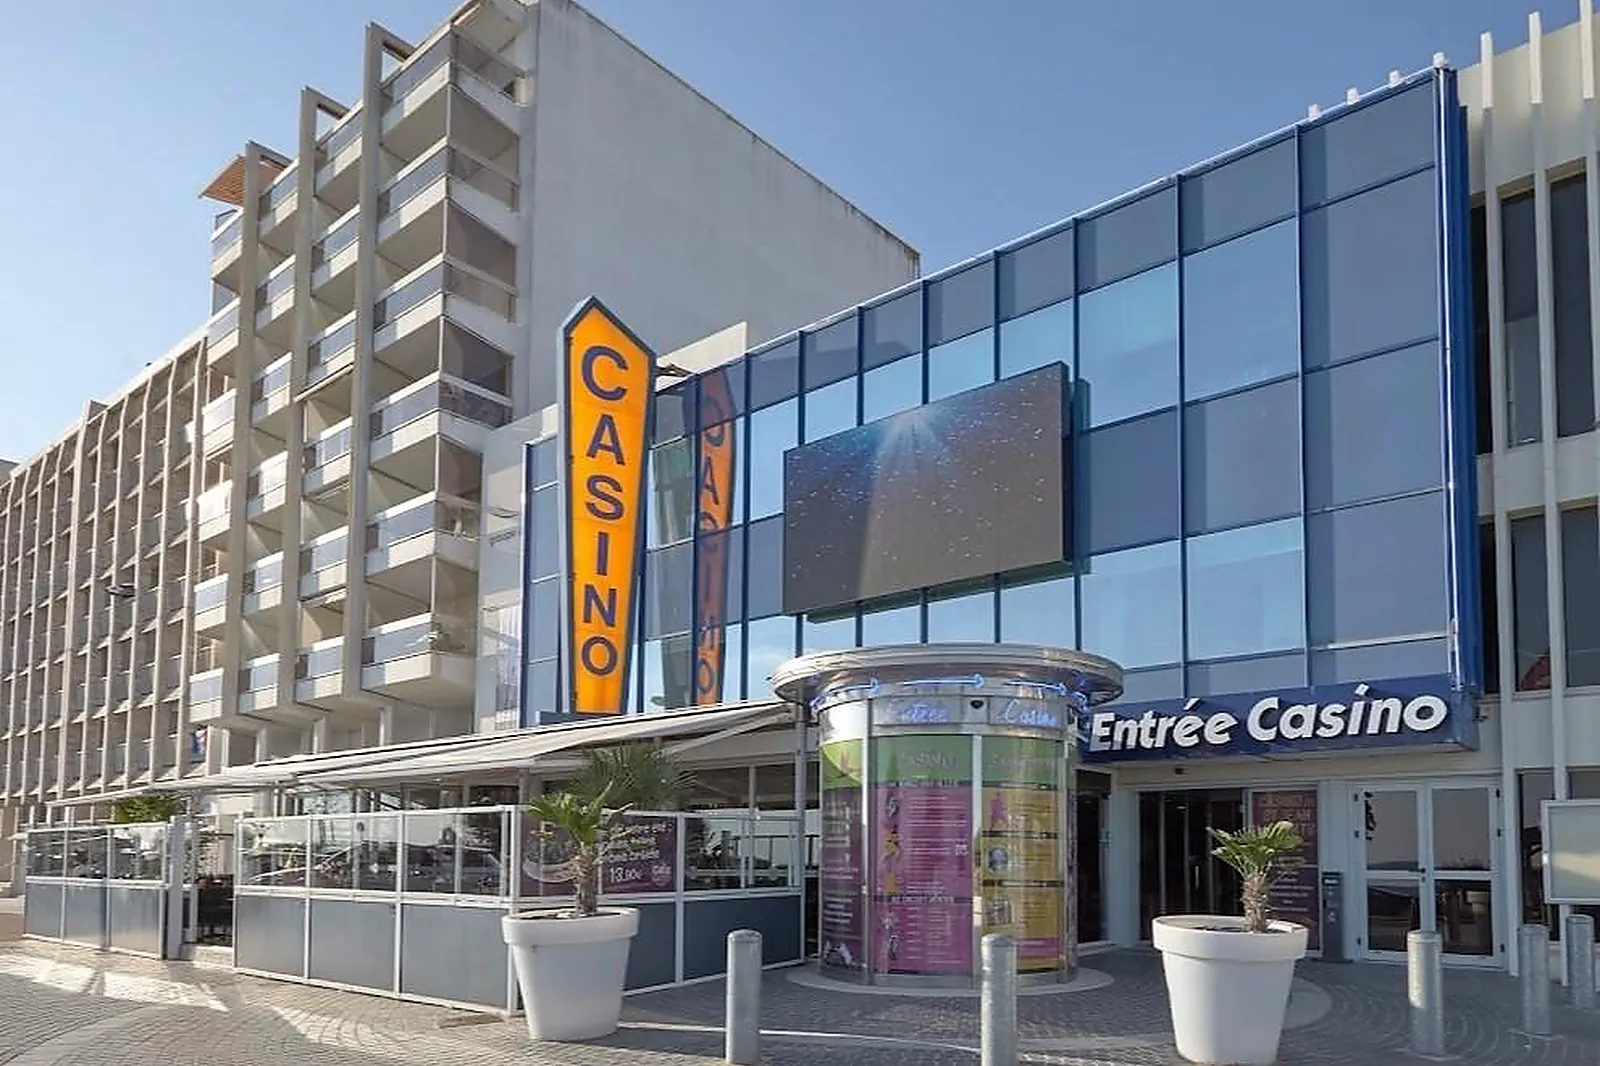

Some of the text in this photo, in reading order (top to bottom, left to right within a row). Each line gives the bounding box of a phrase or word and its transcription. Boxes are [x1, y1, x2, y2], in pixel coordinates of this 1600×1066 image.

[581, 345, 628, 676] CASINO
[1089, 683, 1448, 751] Entrée Casino
